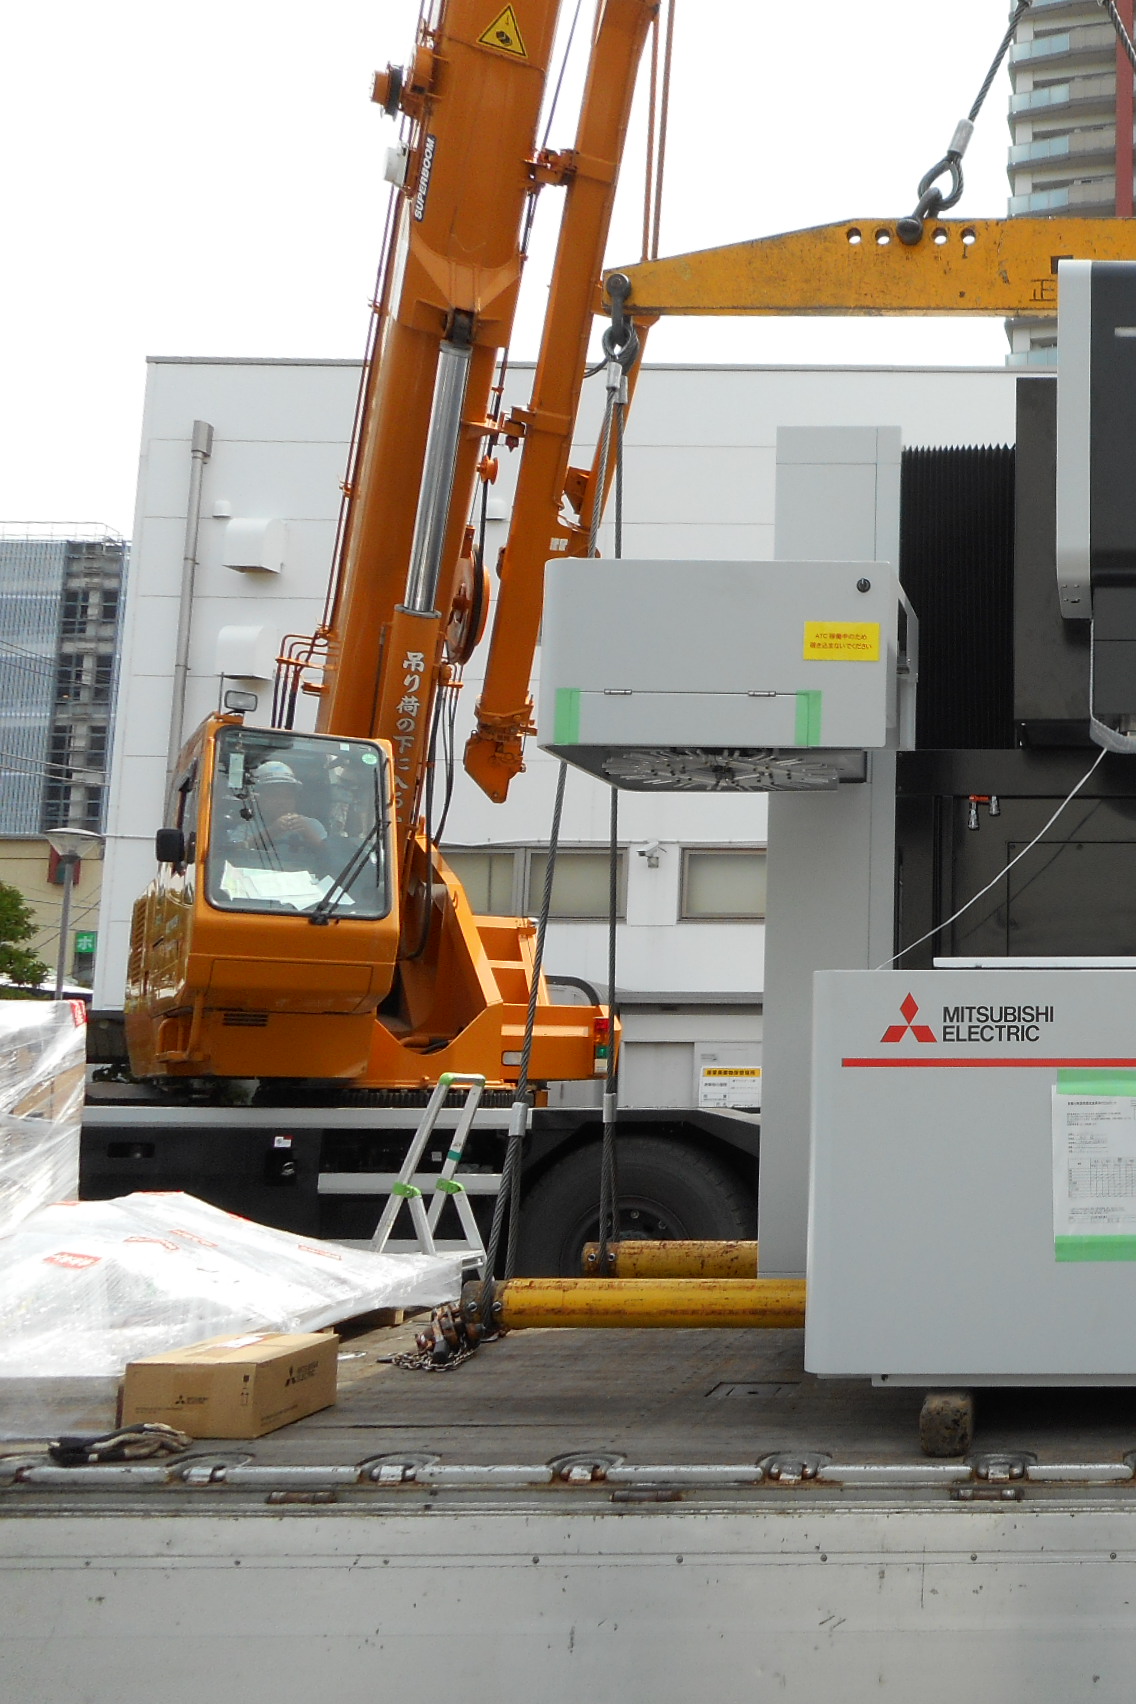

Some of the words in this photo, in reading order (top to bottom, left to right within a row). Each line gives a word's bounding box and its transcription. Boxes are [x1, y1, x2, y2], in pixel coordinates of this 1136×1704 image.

[414, 135, 436, 220] SUPERBOOM
[942, 1005, 1054, 1023] MITSUBISHI
[942, 1025, 1040, 1042] ELECTRIC
